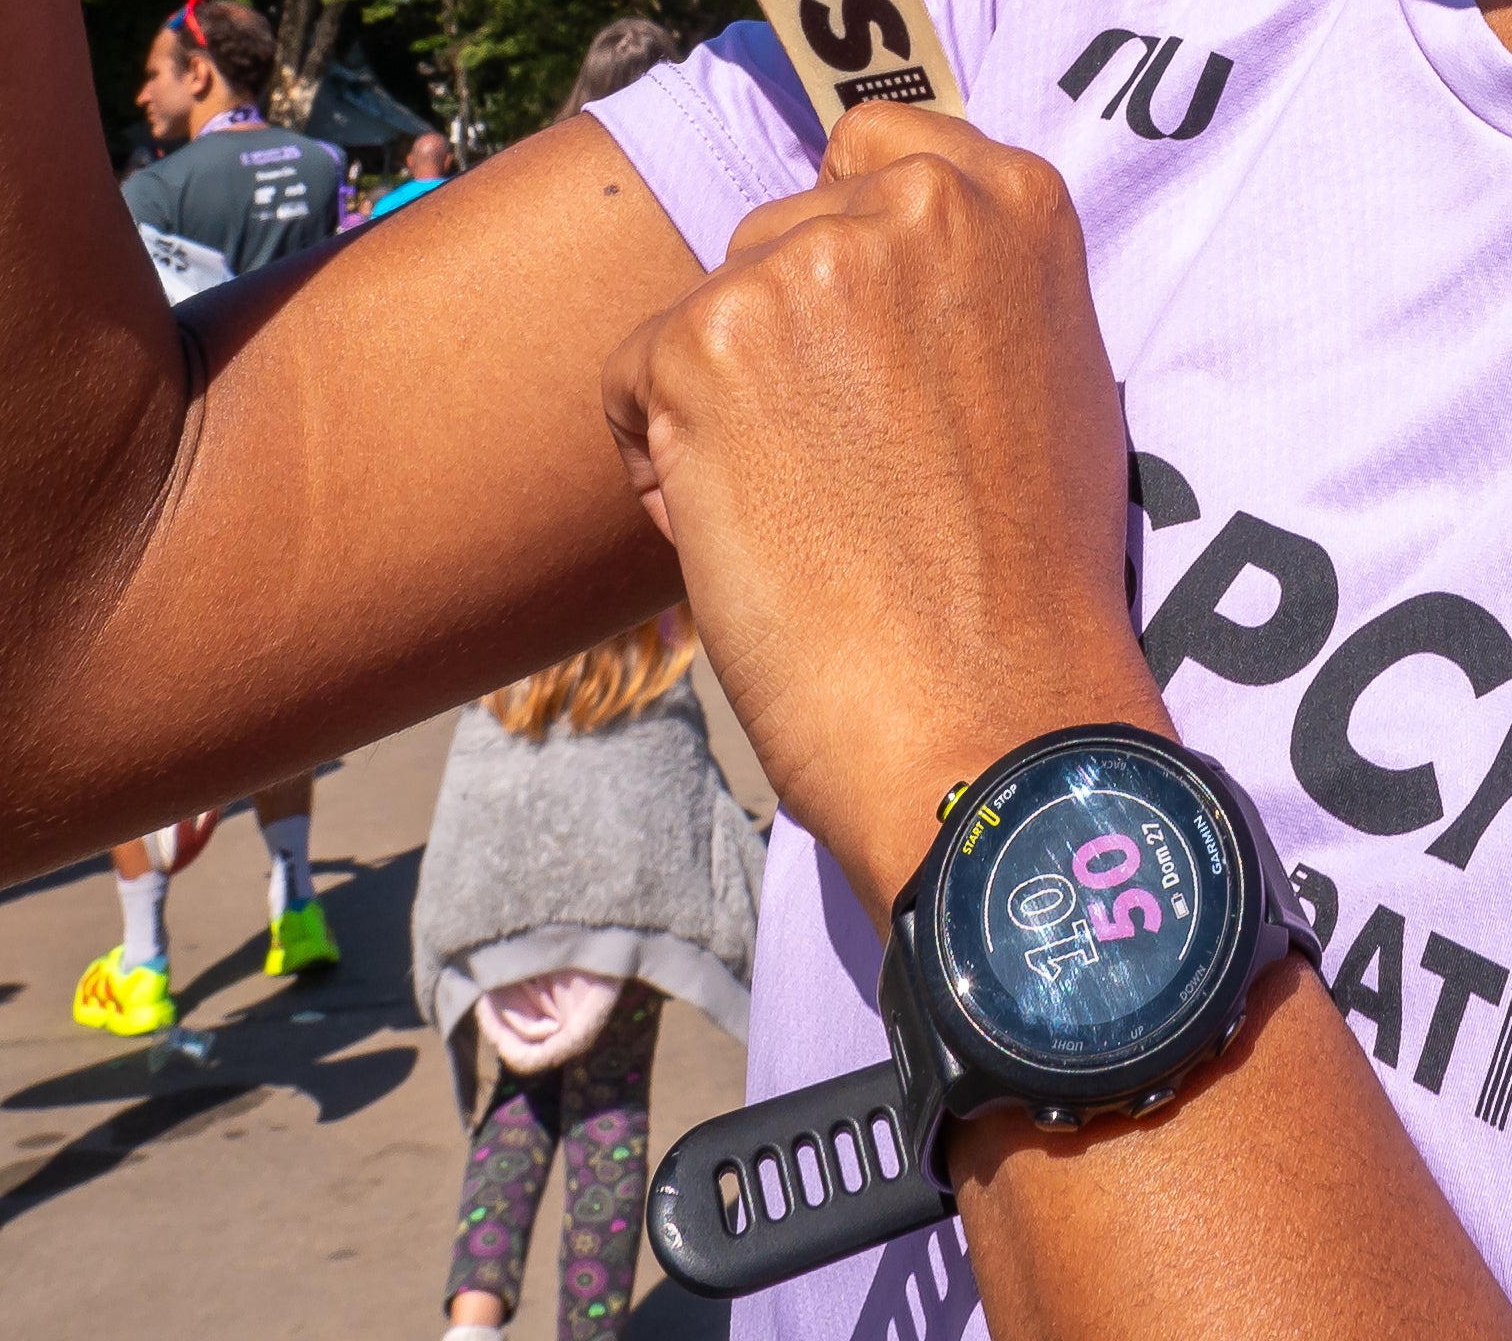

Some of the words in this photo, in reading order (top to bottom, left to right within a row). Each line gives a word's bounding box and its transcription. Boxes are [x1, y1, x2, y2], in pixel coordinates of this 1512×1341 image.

[962, 821, 985, 855] START
[993, 783, 1018, 810] STOP
[1141, 821, 1165, 846] 27
[1193, 814, 1222, 875] GARMIN
[1071, 833, 1163, 942] 50
[1152, 845, 1180, 889] Dom
[1006, 873, 1100, 981] 10
[1178, 963, 1207, 1003] DOWN
[1051, 1040, 1084, 1052] LIGHT
[1130, 1025, 1145, 1040] UP
